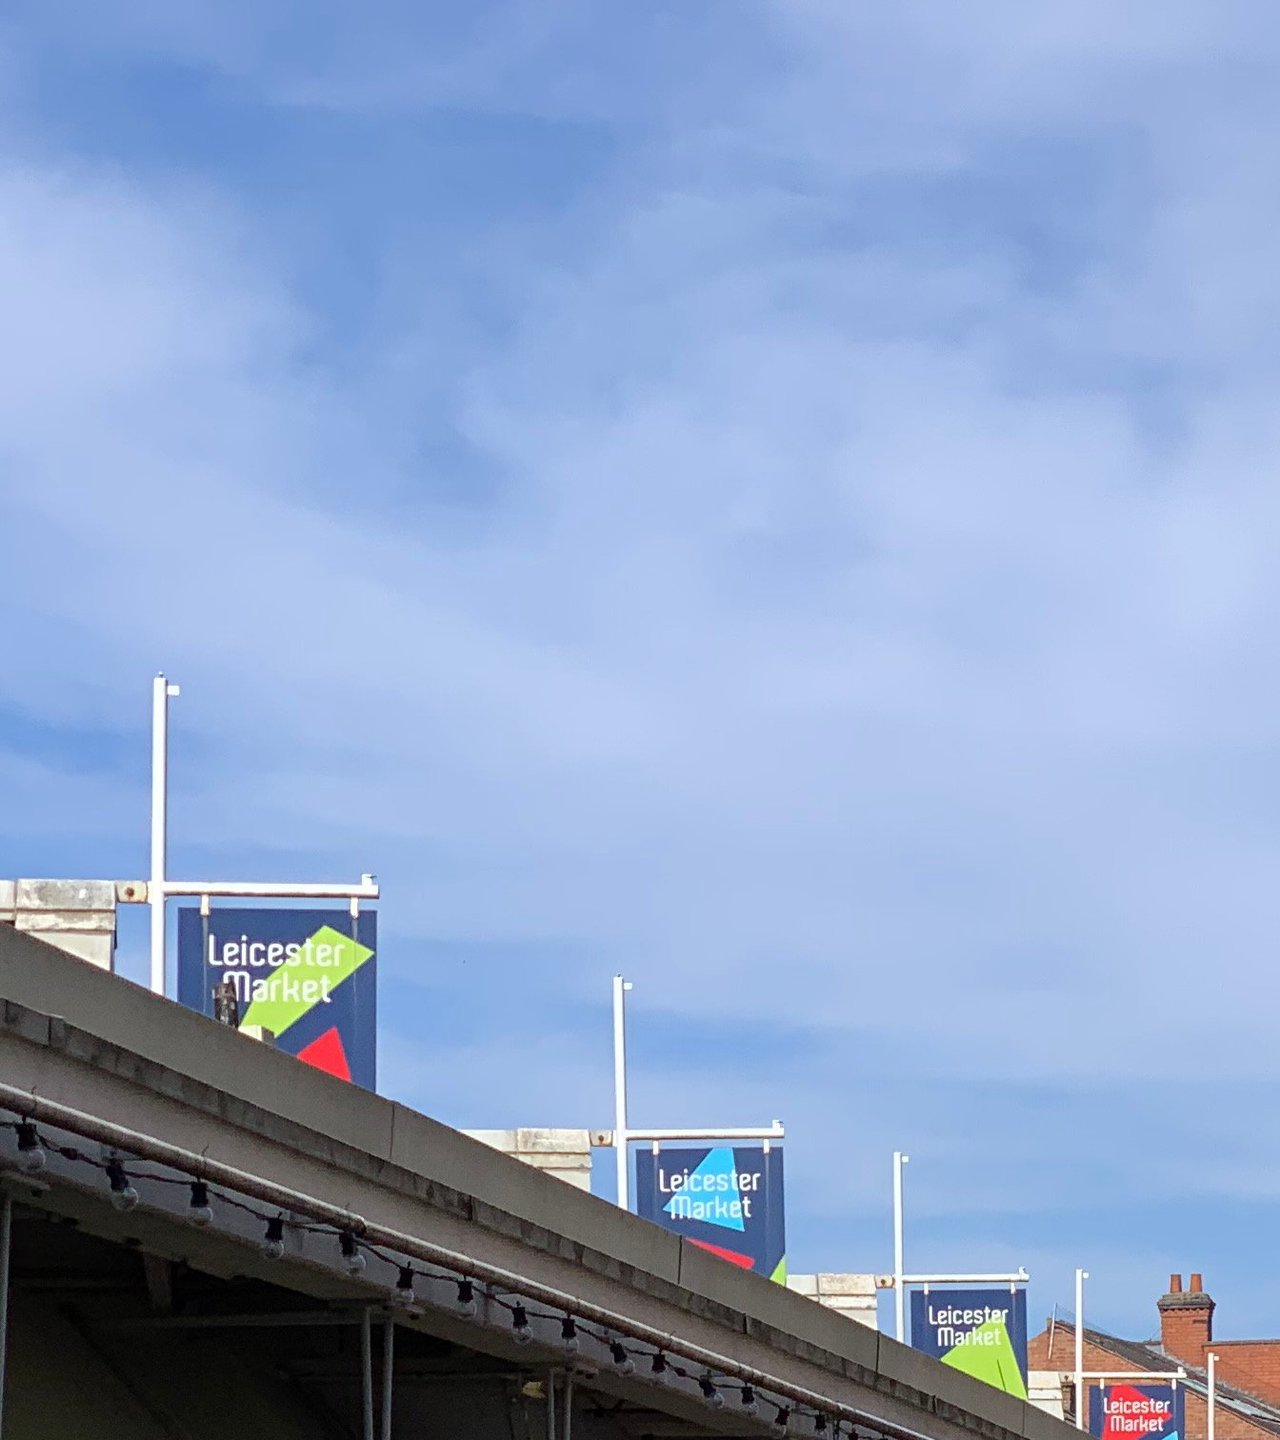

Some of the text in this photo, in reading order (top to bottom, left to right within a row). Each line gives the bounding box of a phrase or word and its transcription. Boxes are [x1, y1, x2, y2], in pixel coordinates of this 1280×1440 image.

[208, 933, 345, 967] Leicester
[223, 971, 332, 1003] Market
[659, 1168, 761, 1192] Leicester
[670, 1195, 752, 1220] Market
[928, 1305, 1009, 1325] Leicester
[937, 1327, 1001, 1346] Market
[1103, 1397, 1171, 1414] Leicester
[1110, 1415, 1164, 1432] Market
